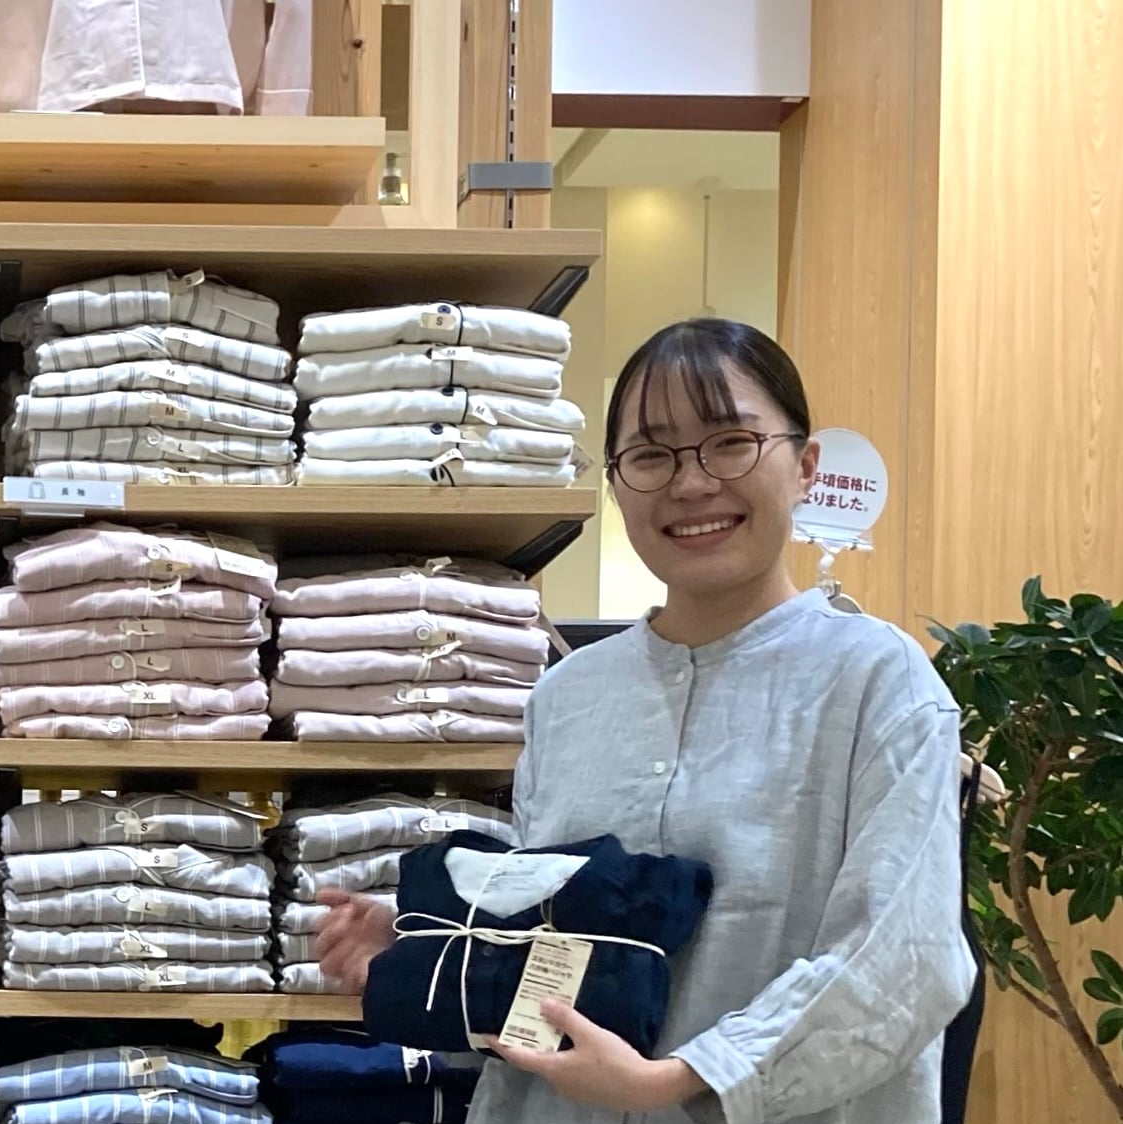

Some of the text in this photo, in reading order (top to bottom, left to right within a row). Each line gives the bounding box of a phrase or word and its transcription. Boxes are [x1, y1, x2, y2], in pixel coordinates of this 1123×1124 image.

[436, 316, 443, 326] S
[165, 407, 174, 416] M
[475, 406, 485, 415] M
[460, 429, 468, 440] L
[178, 443, 184, 453] L
[166, 563, 173, 572] S
[141, 624, 148, 632] L
[446, 632, 457, 642] M
[147, 657, 153, 666] L
[144, 692, 155, 700] XL
[424, 691, 430, 699] L
[140, 821, 148, 832] S
[445, 820, 451, 828] L
[154, 855, 160, 864] S
[145, 902, 151, 911] L
[140, 944, 153, 954] XL
[159, 973, 172, 982] XL
[143, 1062, 152, 1071] M
